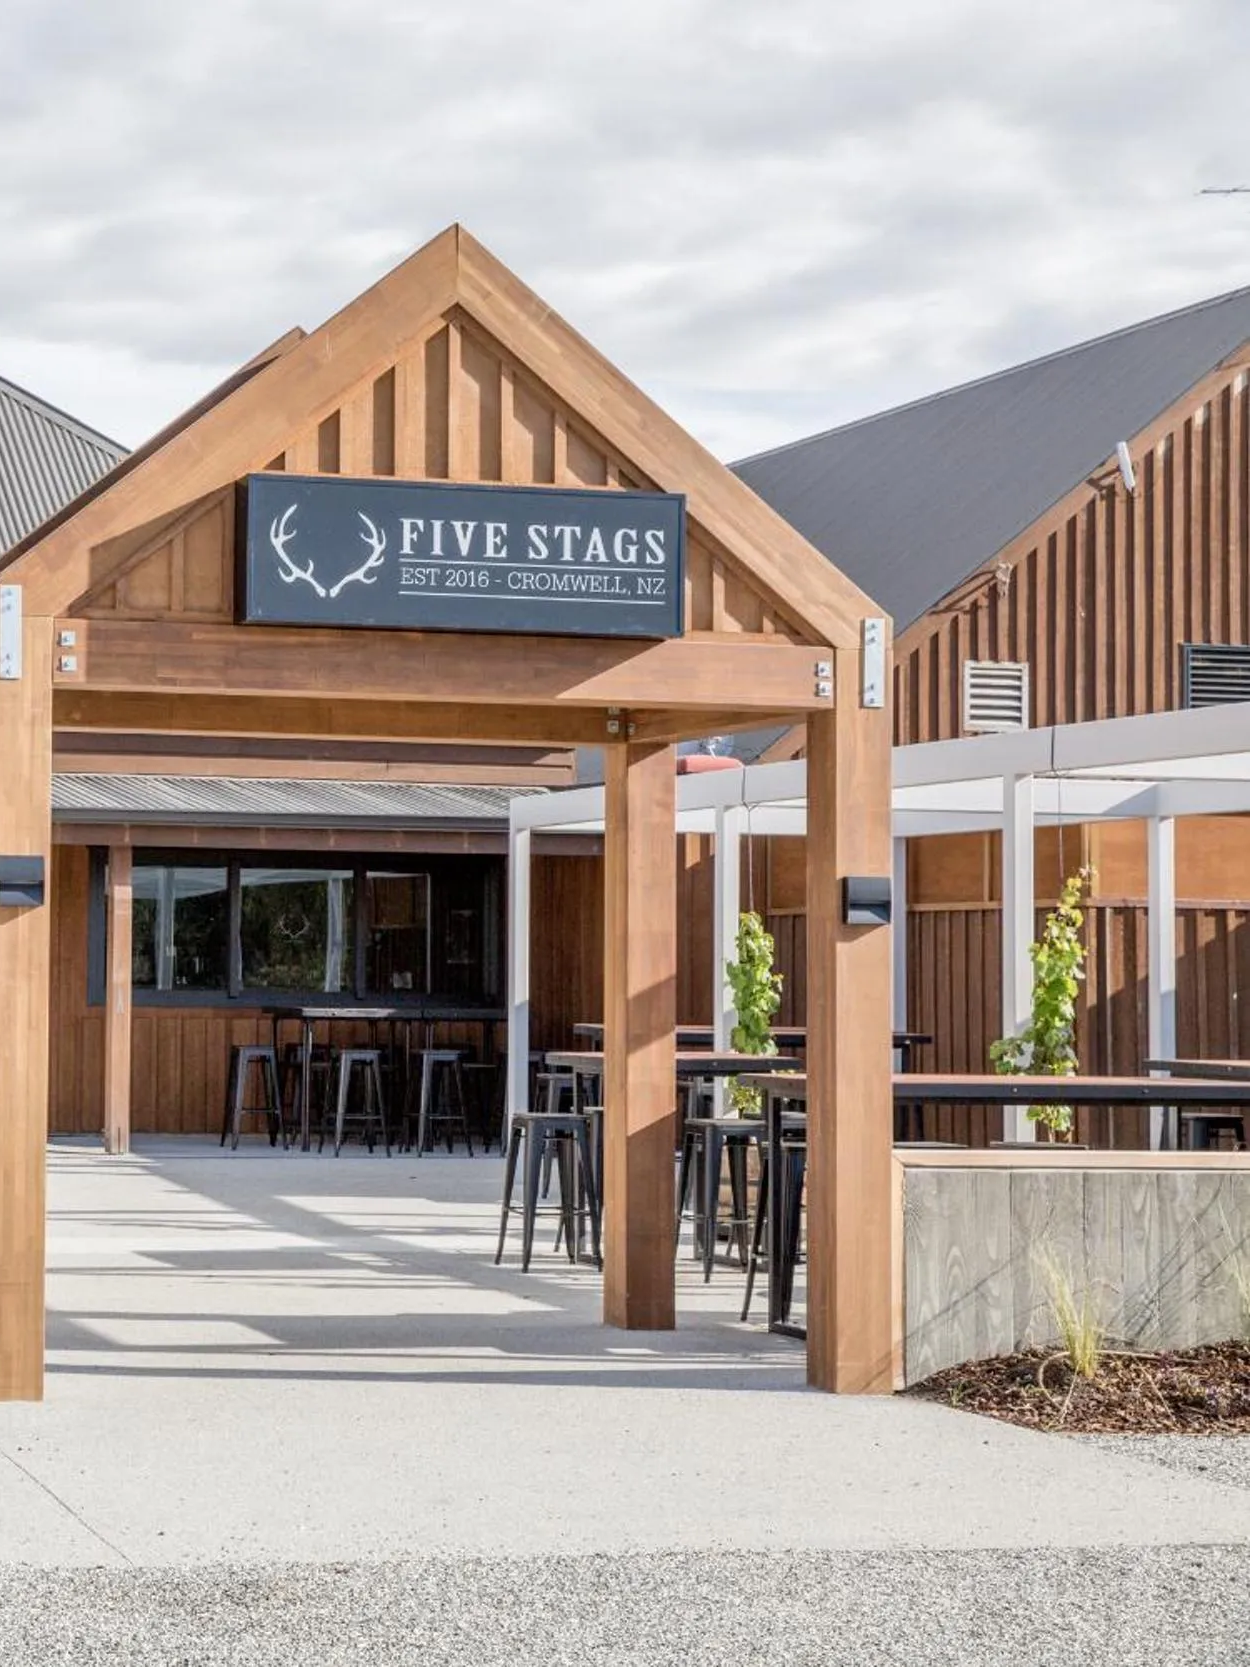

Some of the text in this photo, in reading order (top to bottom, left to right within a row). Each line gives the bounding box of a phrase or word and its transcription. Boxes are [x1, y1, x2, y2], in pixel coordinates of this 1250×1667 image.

[398, 518, 666, 565] FIVE STAGS
[399, 567, 441, 586] EST
[445, 569, 490, 588] 2016
[507, 571, 631, 596] CROMWELL,
[636, 577, 667, 595] NZ
